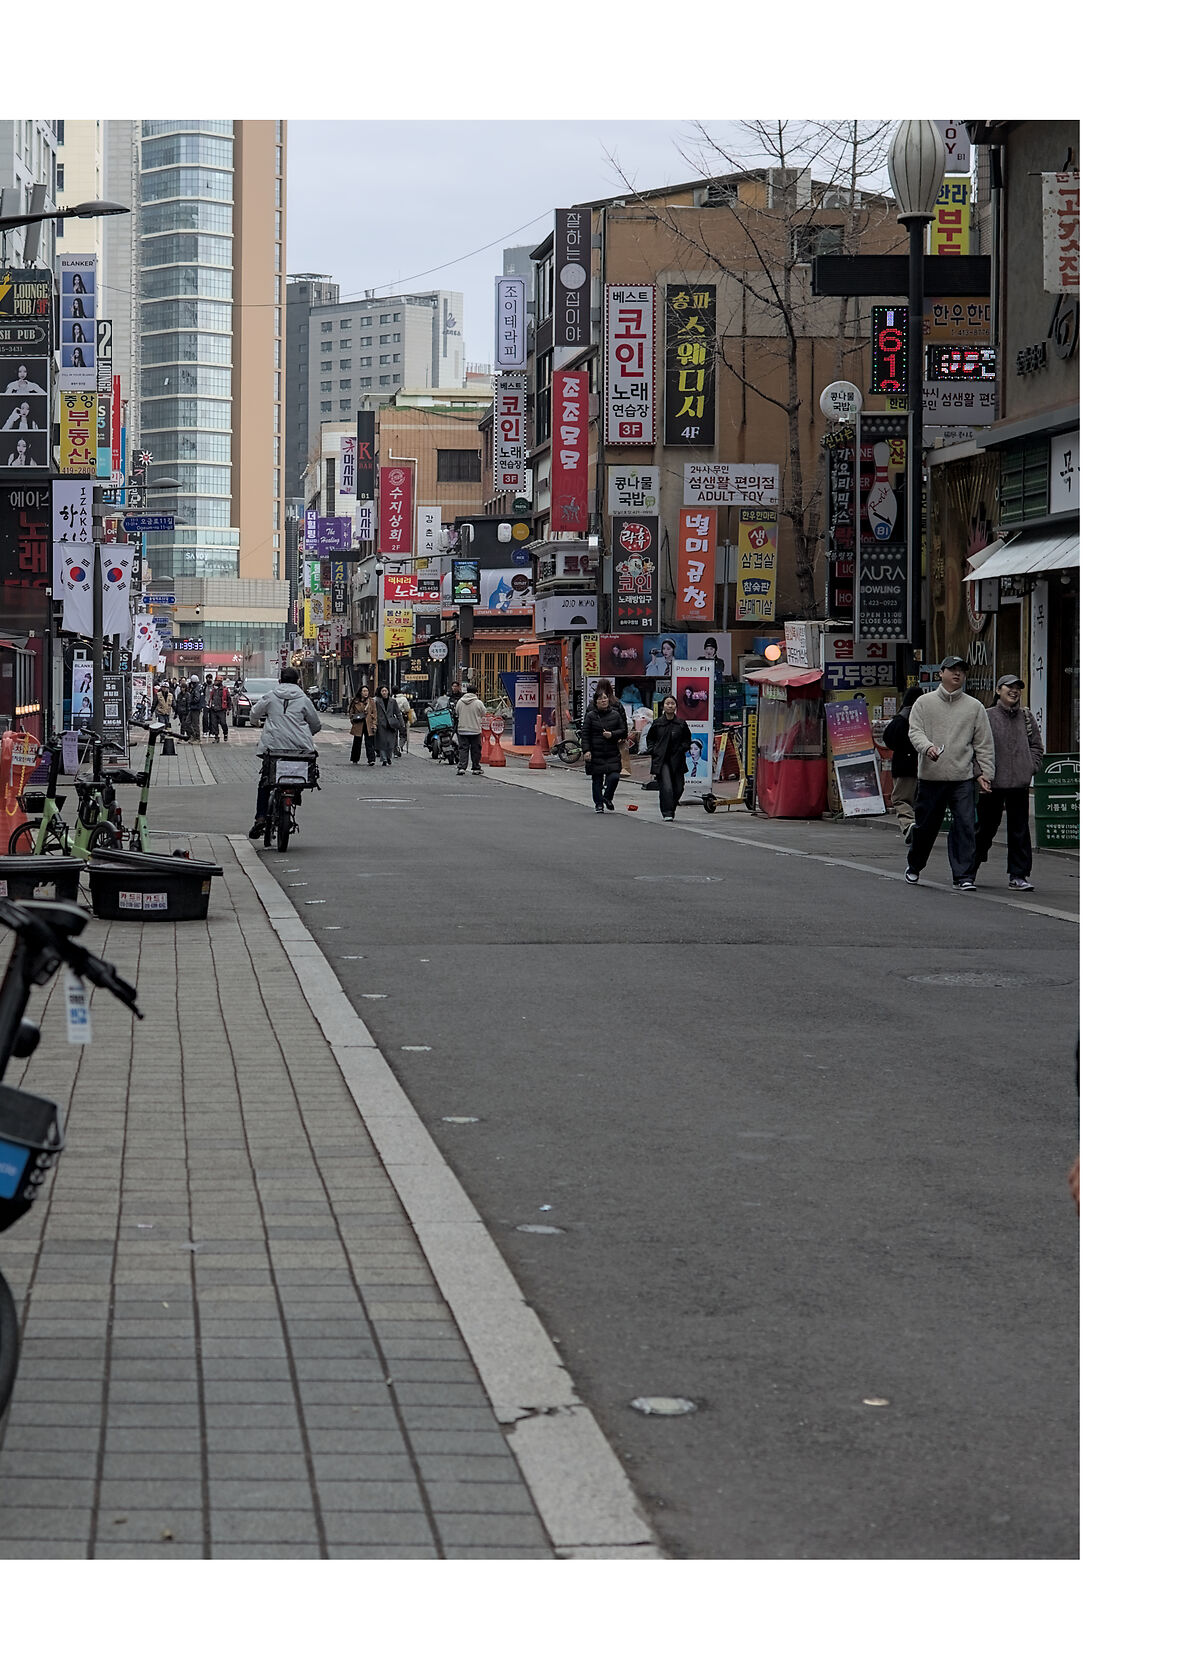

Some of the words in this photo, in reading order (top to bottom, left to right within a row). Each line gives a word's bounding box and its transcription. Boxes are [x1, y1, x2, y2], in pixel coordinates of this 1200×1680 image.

[566, 213, 581, 261] 잘하는
[13, 283, 48, 299] LOUNGE
[612, 291, 649, 304] 베스트
[671, 291, 710, 310] 송파
[504, 285, 518, 359] 조이테라피
[565, 291, 581, 341] 집이야
[17, 329, 36, 340] PUB
[614, 308, 647, 378] 코인
[500, 382, 522, 391] 베스트
[612, 382, 648, 401] 노래
[64, 395, 95, 408] 중앙
[830, 392, 854, 402] 콩나물
[941, 392, 975, 407] 성생활
[612, 403, 649, 418] 연습장
[833, 402, 850, 411] 국밥
[500, 396, 521, 442] 코인
[559, 376, 580, 470] 조조모모
[68, 410, 91, 465] 부동산
[621, 424, 641, 435] 3F
[680, 426, 701, 439] 4F
[500, 446, 521, 459] 노래
[343, 454, 355, 486] 마사지
[500, 460, 521, 470] 연습장
[505, 475, 517, 483] 3F
[614, 476, 653, 490] 콩나물
[689, 476, 730, 489] 성생활
[734, 476, 775, 489] 편의점
[618, 491, 646, 507] 국밥
[697, 491, 734, 501] ADULT
[743, 491, 764, 501] TOY
[389, 486, 403, 542] 수지상회
[742, 510, 776, 520] 한우한마리
[360, 508, 372, 539] 마사지
[685, 513, 710, 553] 별미
[750, 530, 767, 547] 생
[741, 552, 775, 569] 삼겹살
[860, 565, 906, 580] AURA
[618, 575, 652, 593] 코인
[683, 559, 707, 609] 곱창
[860, 585, 901, 594] BOWLING
[618, 595, 652, 604] 노래방입구
[738, 599, 773, 616] 갈매기살
[174, 642, 204, 650] 11:39:33
[584, 642, 597, 671] 부동산
[827, 665, 894, 686] 구두병원
